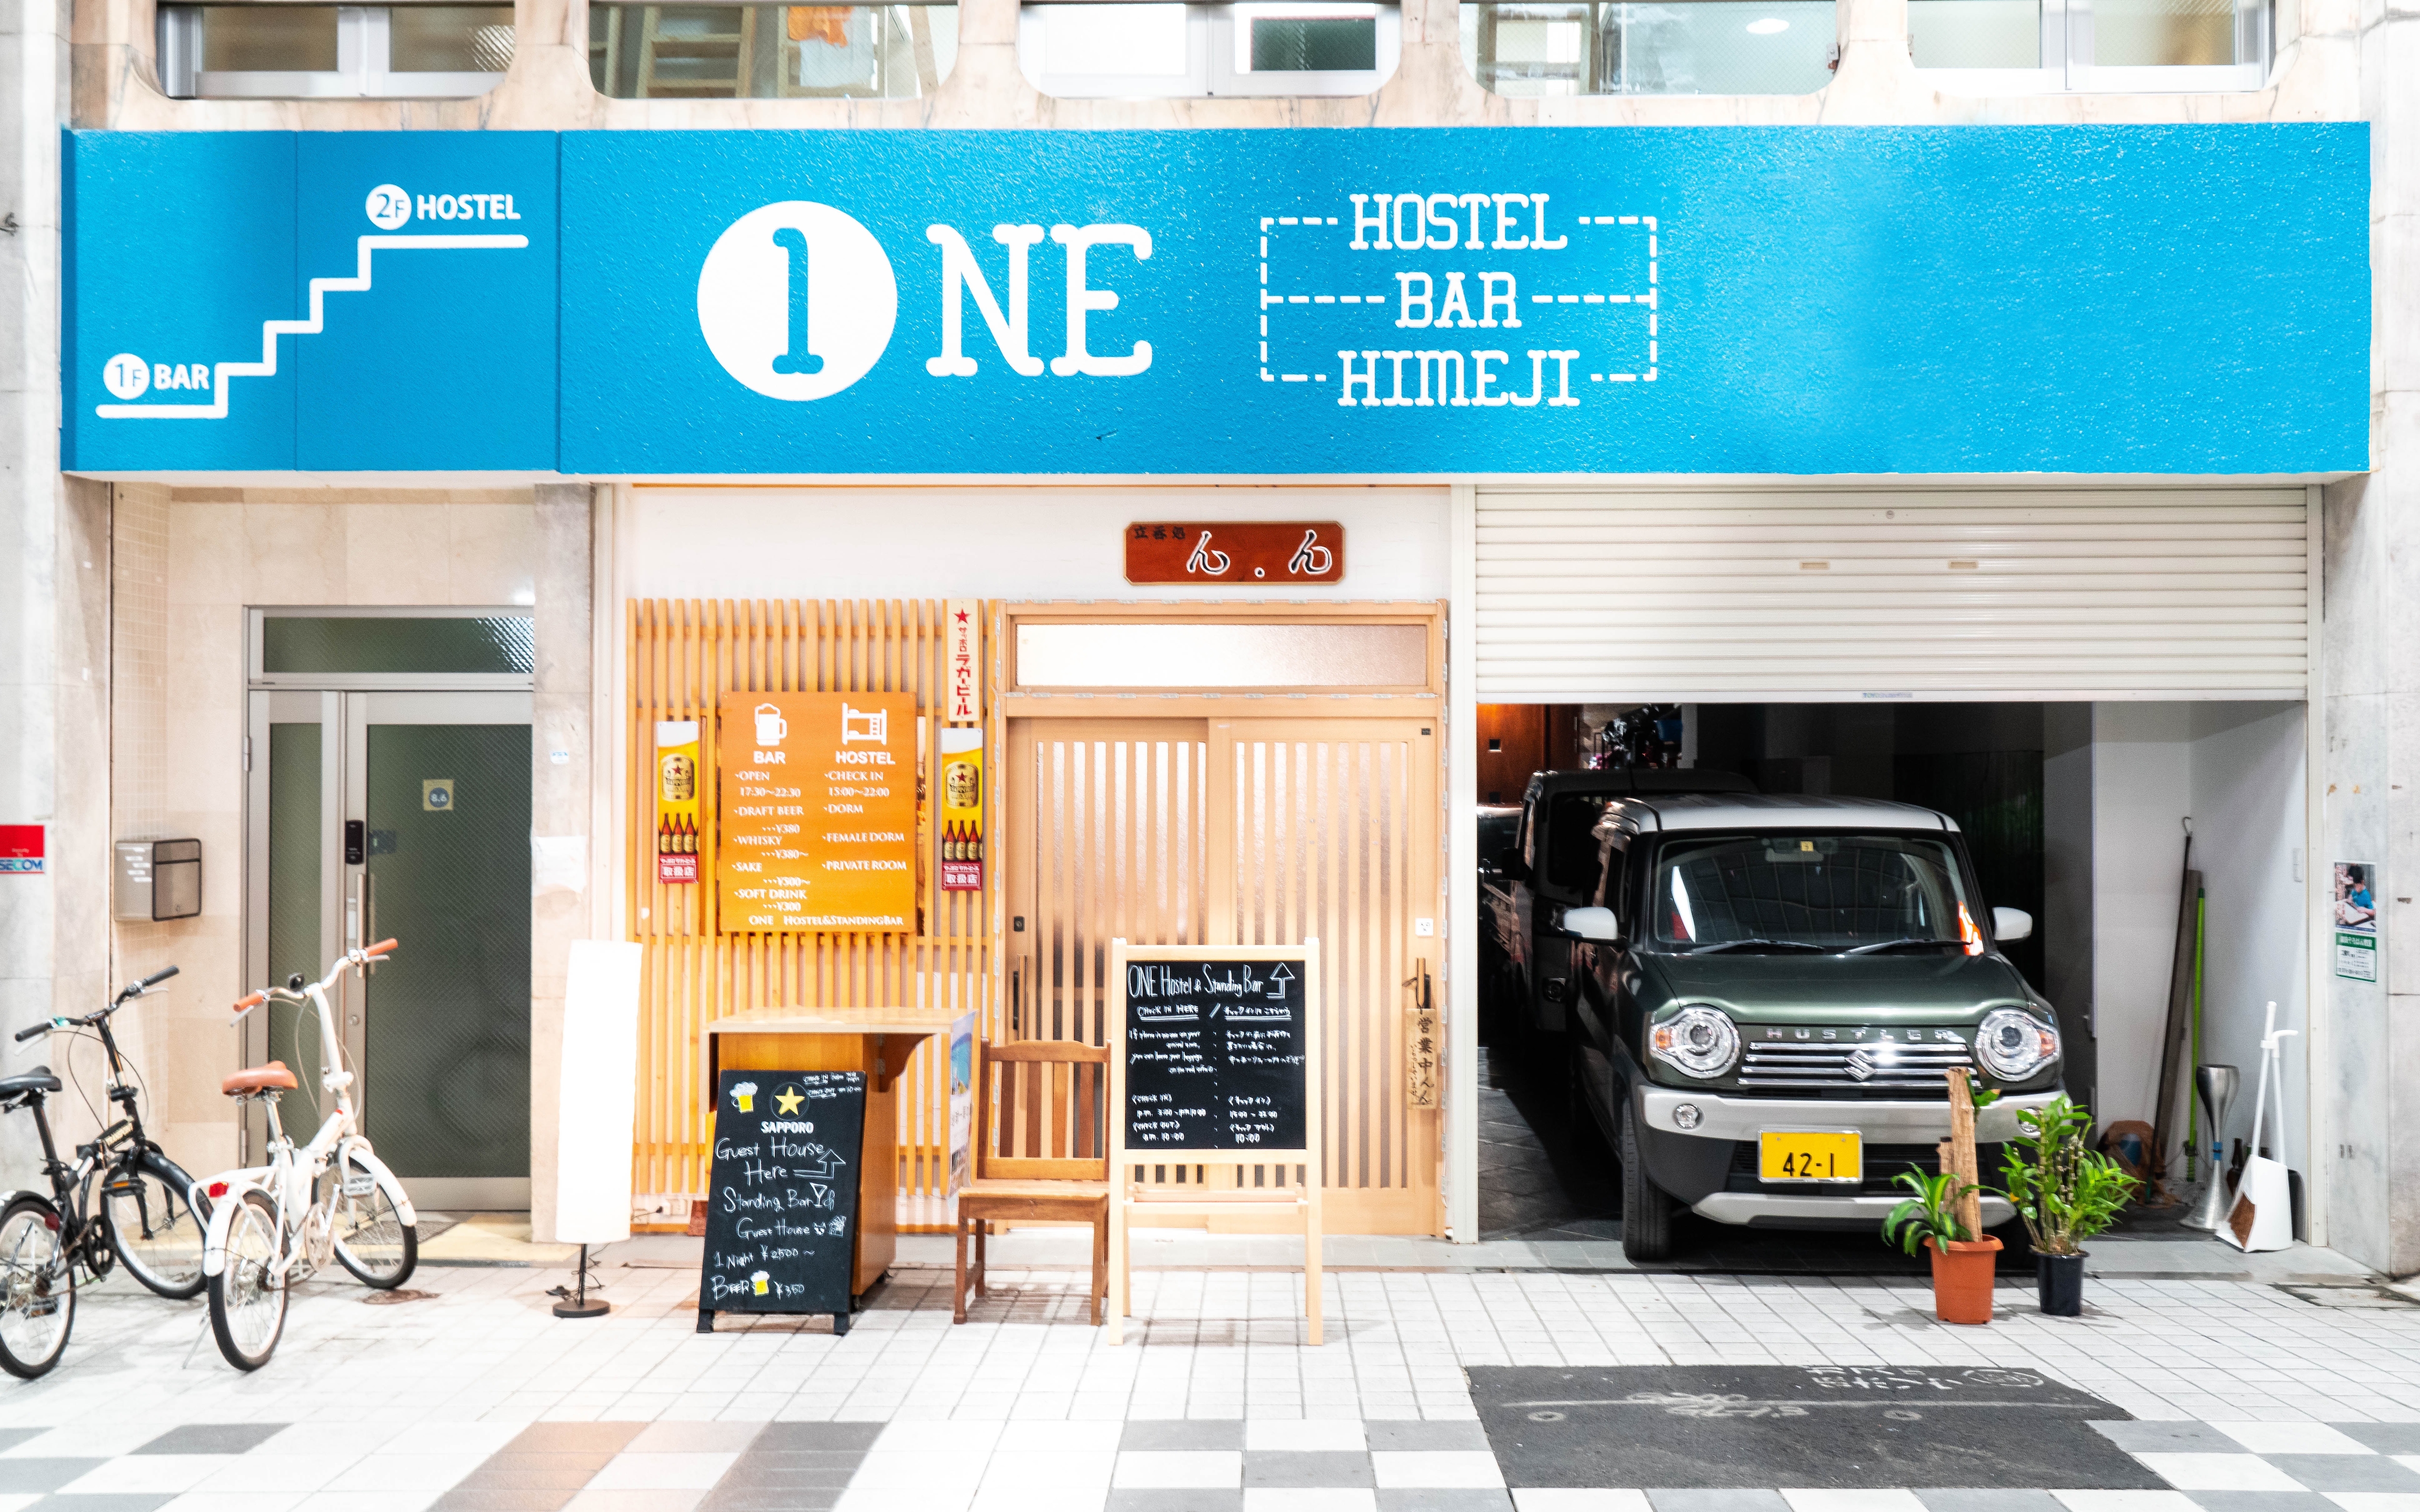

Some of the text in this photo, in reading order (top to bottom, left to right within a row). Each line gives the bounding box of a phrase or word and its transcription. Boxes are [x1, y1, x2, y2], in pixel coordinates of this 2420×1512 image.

[376, 192, 521, 220] 2F HOSTEL
[1349, 194, 1568, 250] HOSTEL
[1395, 272, 1522, 328] BAR
[114, 363, 210, 390] 1F BAR
[1337, 350, 1580, 407] HIMEJI
[753, 751, 786, 764] BAR
[835, 751, 896, 765] HOSTEL
[870, 771, 883, 781] IN
[777, 806, 804, 816] BEER
[871, 832, 905, 842] DORM
[871, 861, 907, 871] ROOM
[769, 889, 807, 900] DRINK
[748, 915, 774, 925] ONE
[1127, 964, 1158, 998] ONE
[1160, 965, 1192, 997] Hostel
[1202, 963, 1242, 998] Standing
[1243, 964, 1264, 994] Bar
[1164, 1005, 1172, 1014] IN
[1176, 1004, 1199, 1014] HERE
[1766, 1028, 1951, 1041] HUSTLER
[760, 1121, 815, 1134] SAPPORO
[715, 1136, 825, 1161] Guest House
[743, 1159, 788, 1186] Here
[1783, 1152, 1835, 1177] 42-1
[723, 1186, 785, 1213] Standing
[786, 1188, 814, 1209] Bar
[736, 1217, 810, 1240] Guest House
[726, 1252, 754, 1270] Night
